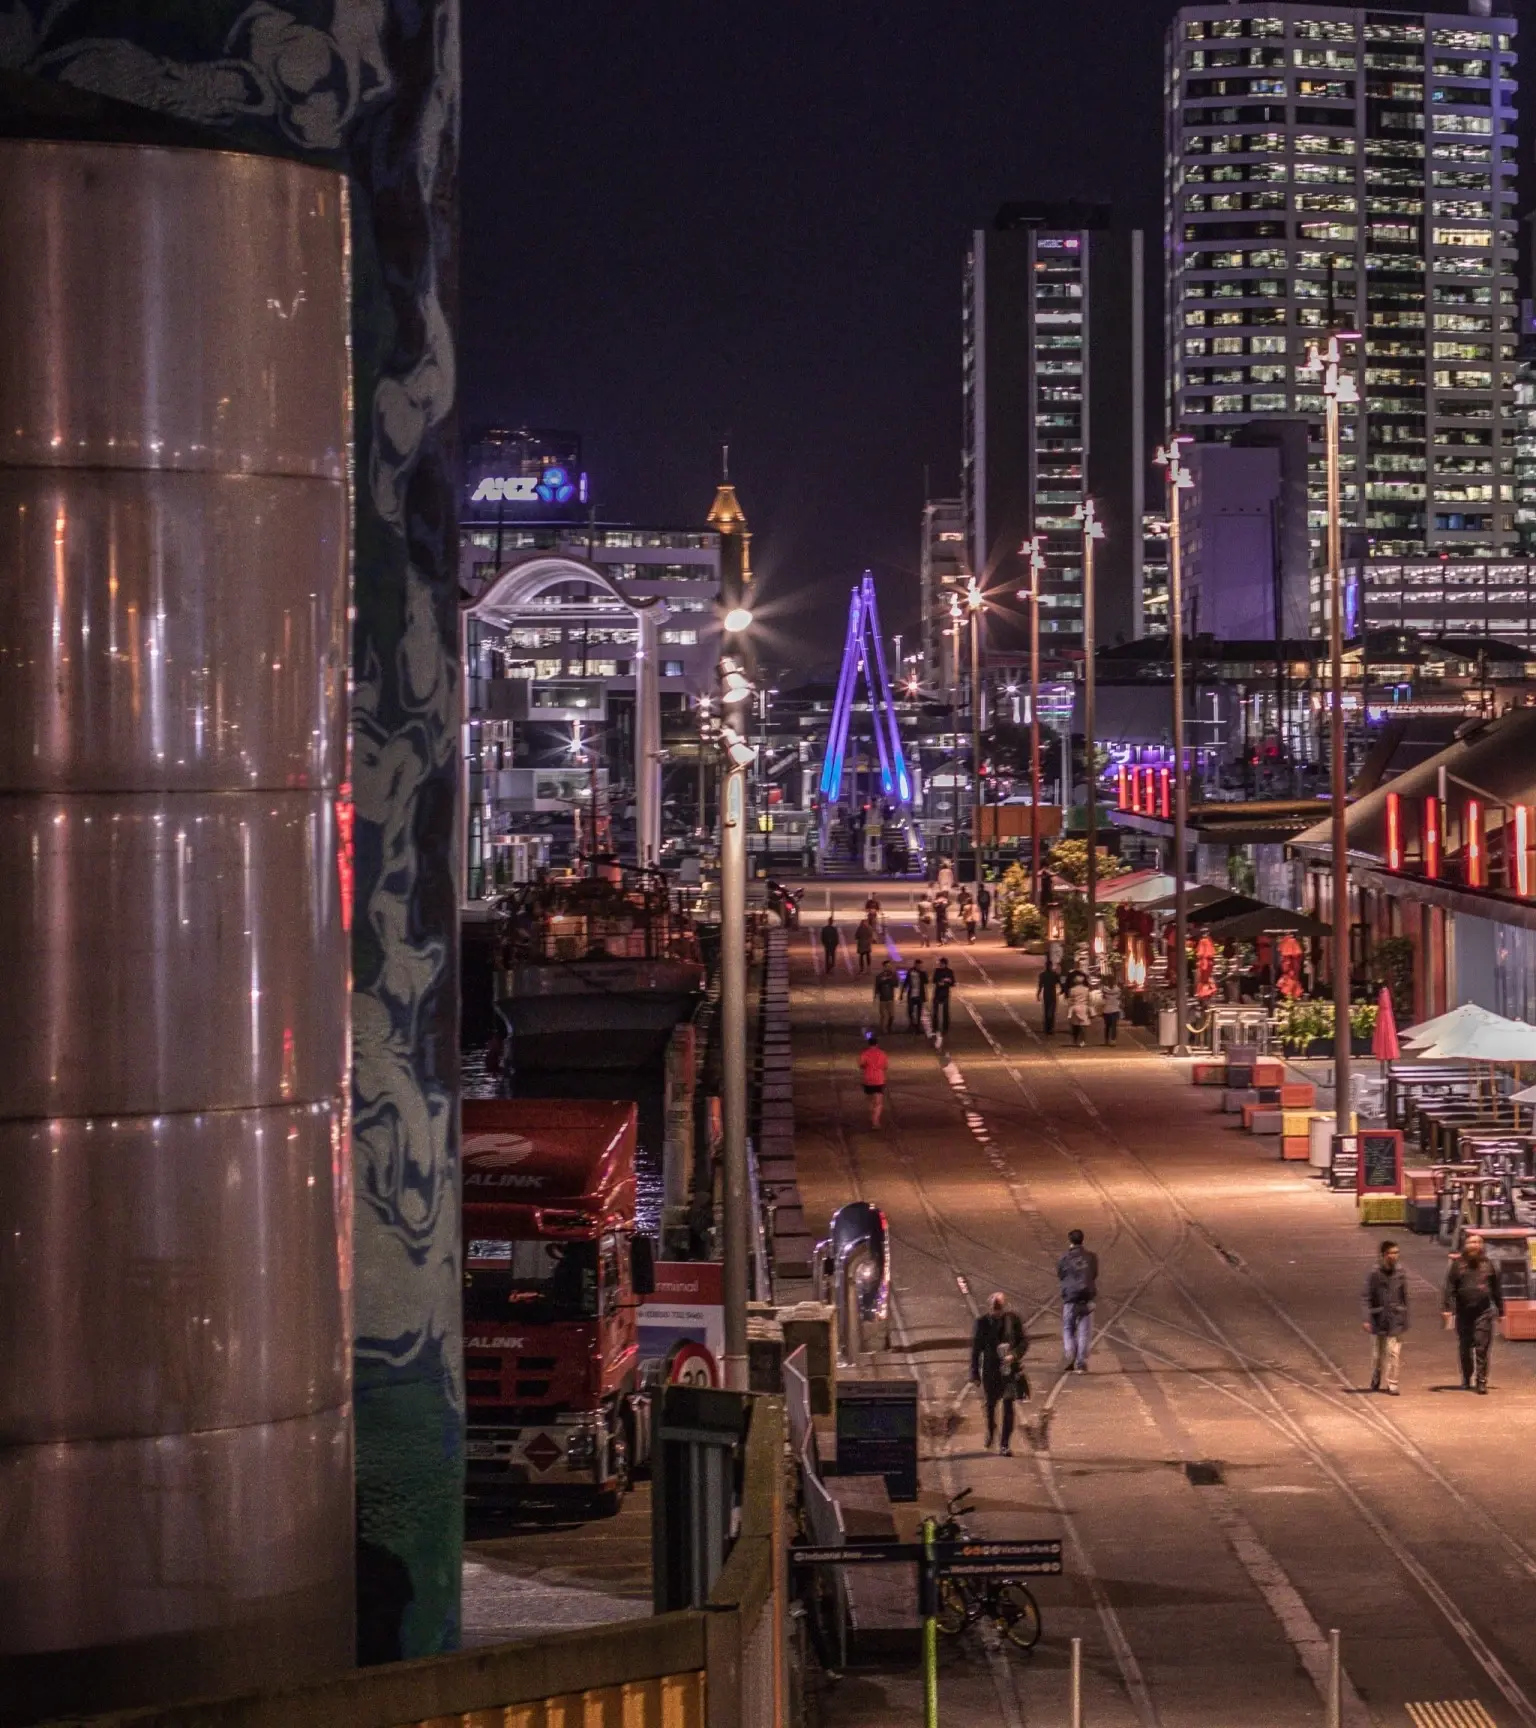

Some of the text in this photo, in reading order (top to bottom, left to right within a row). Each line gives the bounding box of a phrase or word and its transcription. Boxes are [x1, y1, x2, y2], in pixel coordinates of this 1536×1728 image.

[471, 478, 538, 500] ANZ
[463, 1173, 547, 1187] ALINK
[655, 1280, 699, 1292] rminal
[461, 1336, 525, 1348] EALINK
